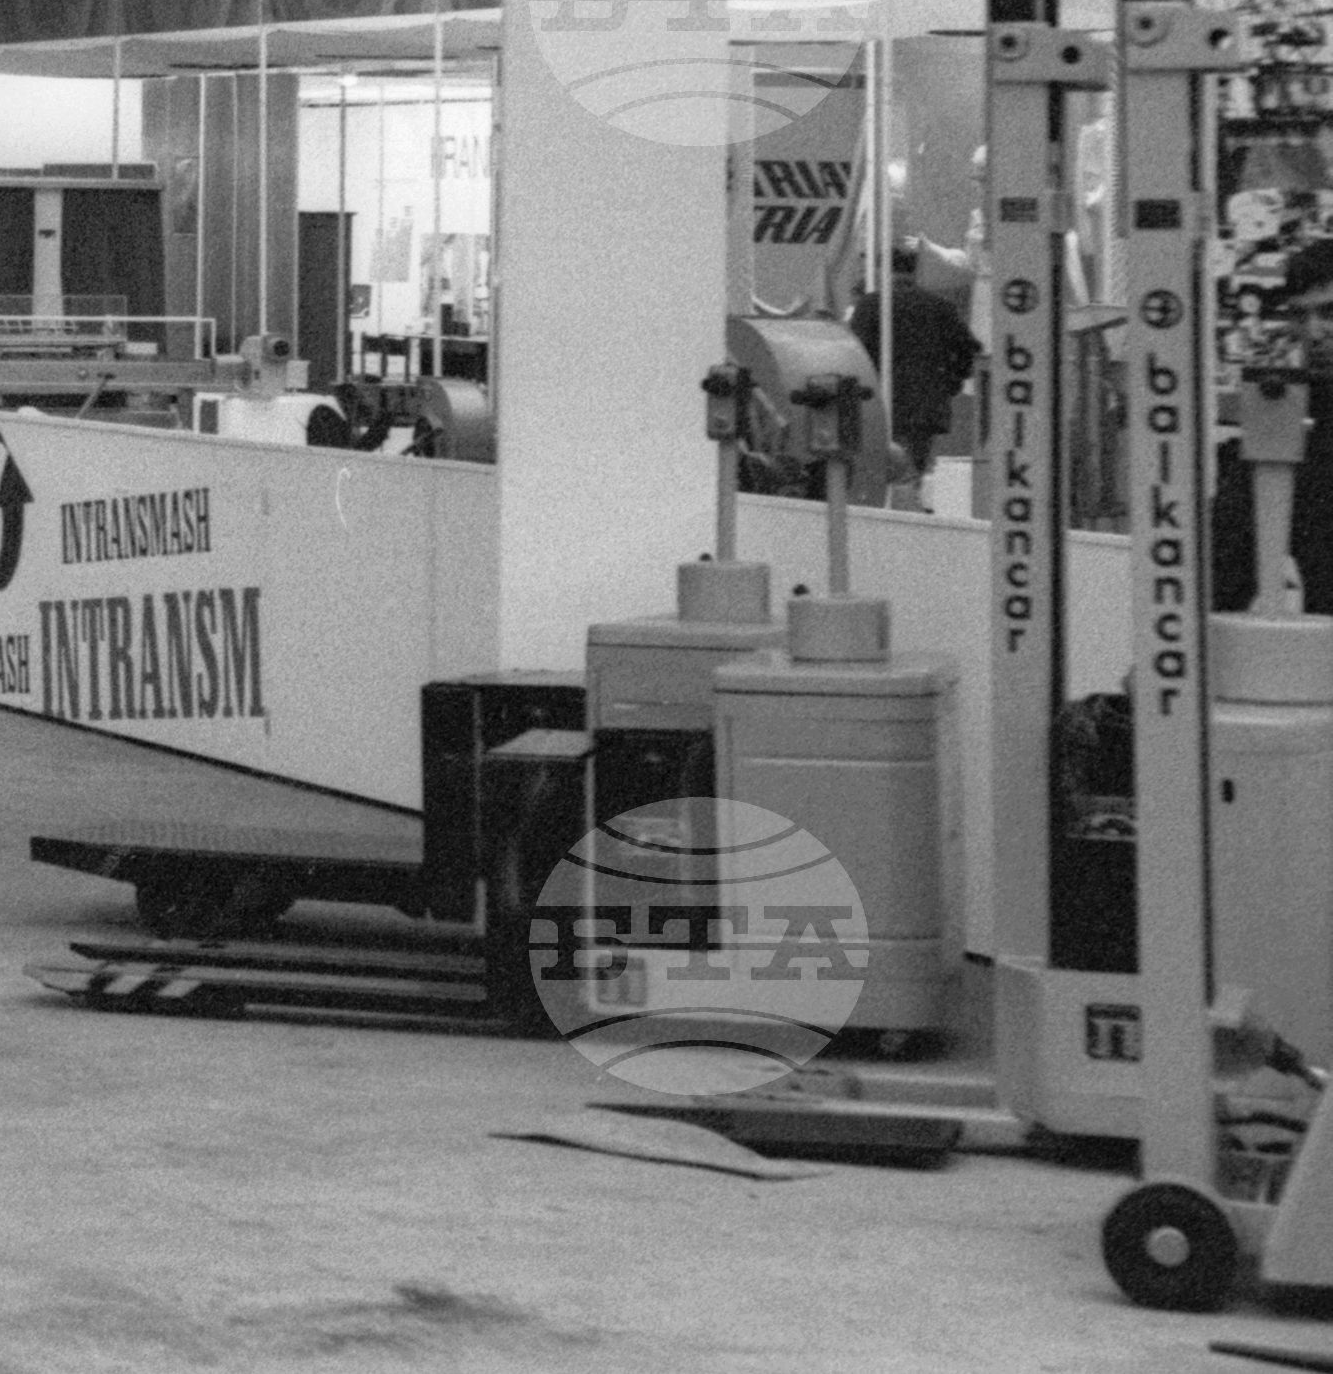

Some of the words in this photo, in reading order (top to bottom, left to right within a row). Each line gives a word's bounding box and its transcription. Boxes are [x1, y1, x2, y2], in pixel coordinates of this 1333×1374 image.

[60, 488, 211, 564] INTRANSMASH
[1005, 333, 1032, 653] balkancar
[1147, 352, 1187, 717] balkancar
[39, 587, 265, 721] INTRANSM
